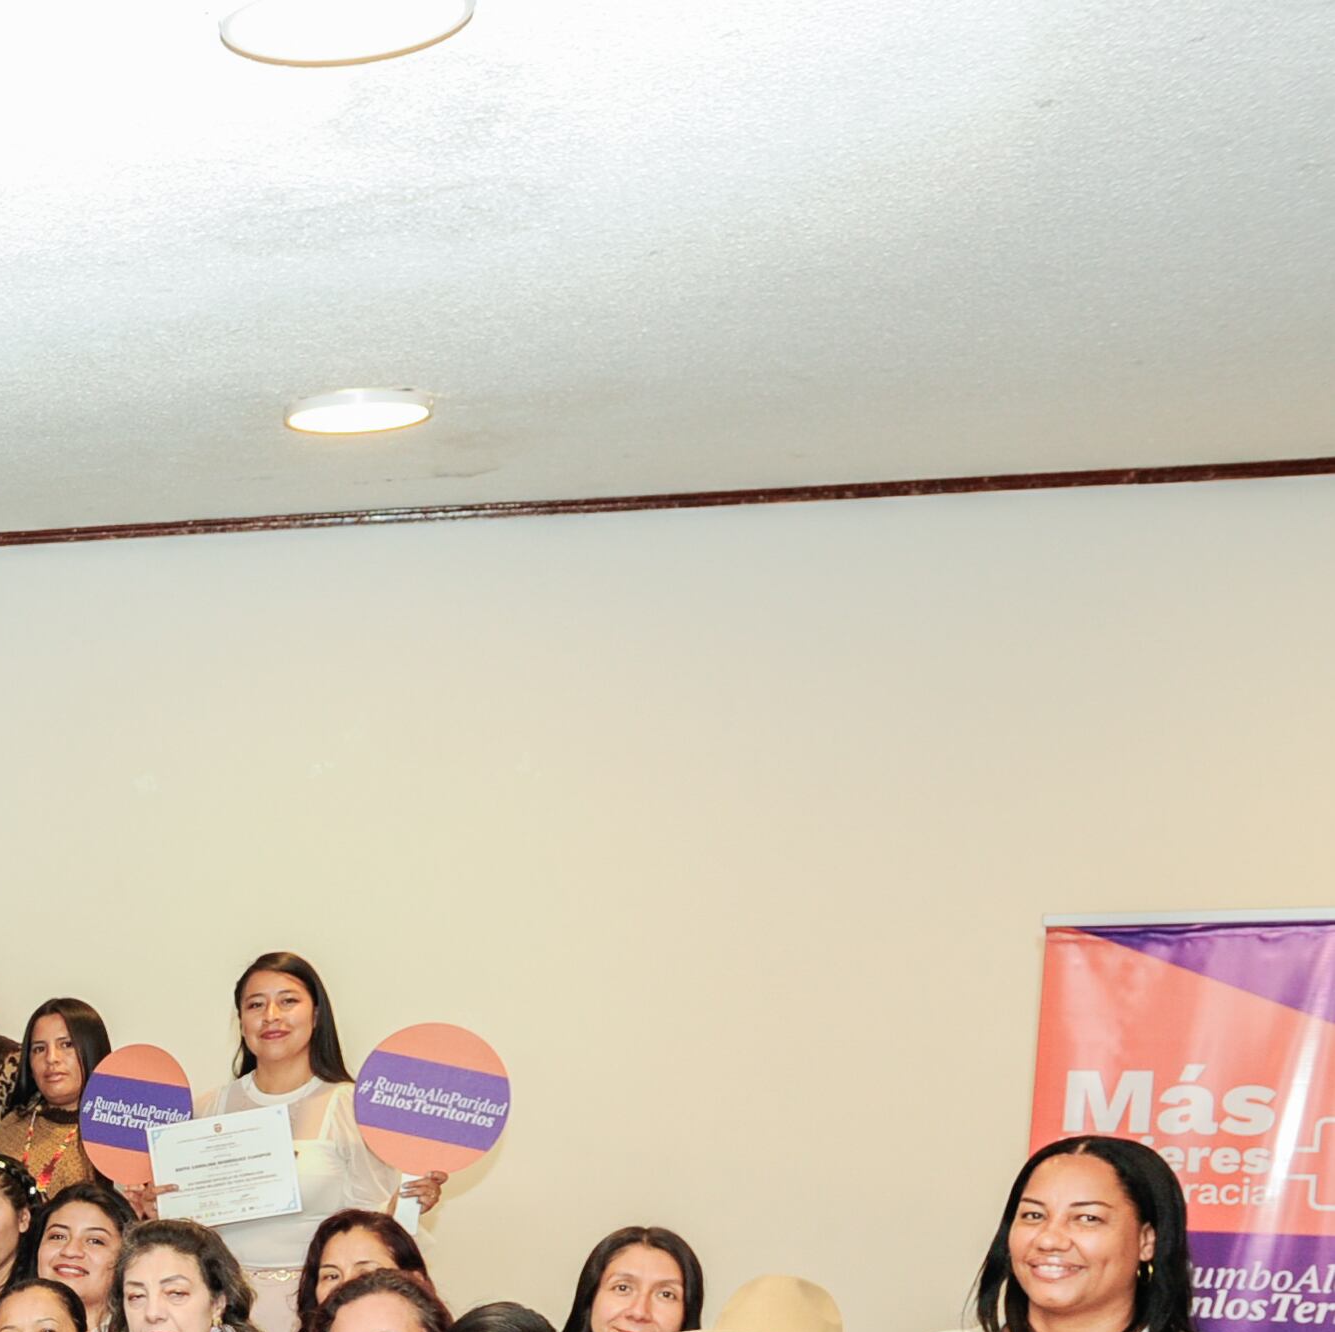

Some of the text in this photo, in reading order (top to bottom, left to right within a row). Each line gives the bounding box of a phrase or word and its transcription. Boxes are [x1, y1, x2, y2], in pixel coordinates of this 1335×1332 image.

[94, 1096, 191, 1121] RumboAlaParidad
[370, 1090, 495, 1128] EnlosTerritorios
[374, 1076, 508, 1116] RumboAlaParidad
[1062, 1063, 1276, 1136] Más
